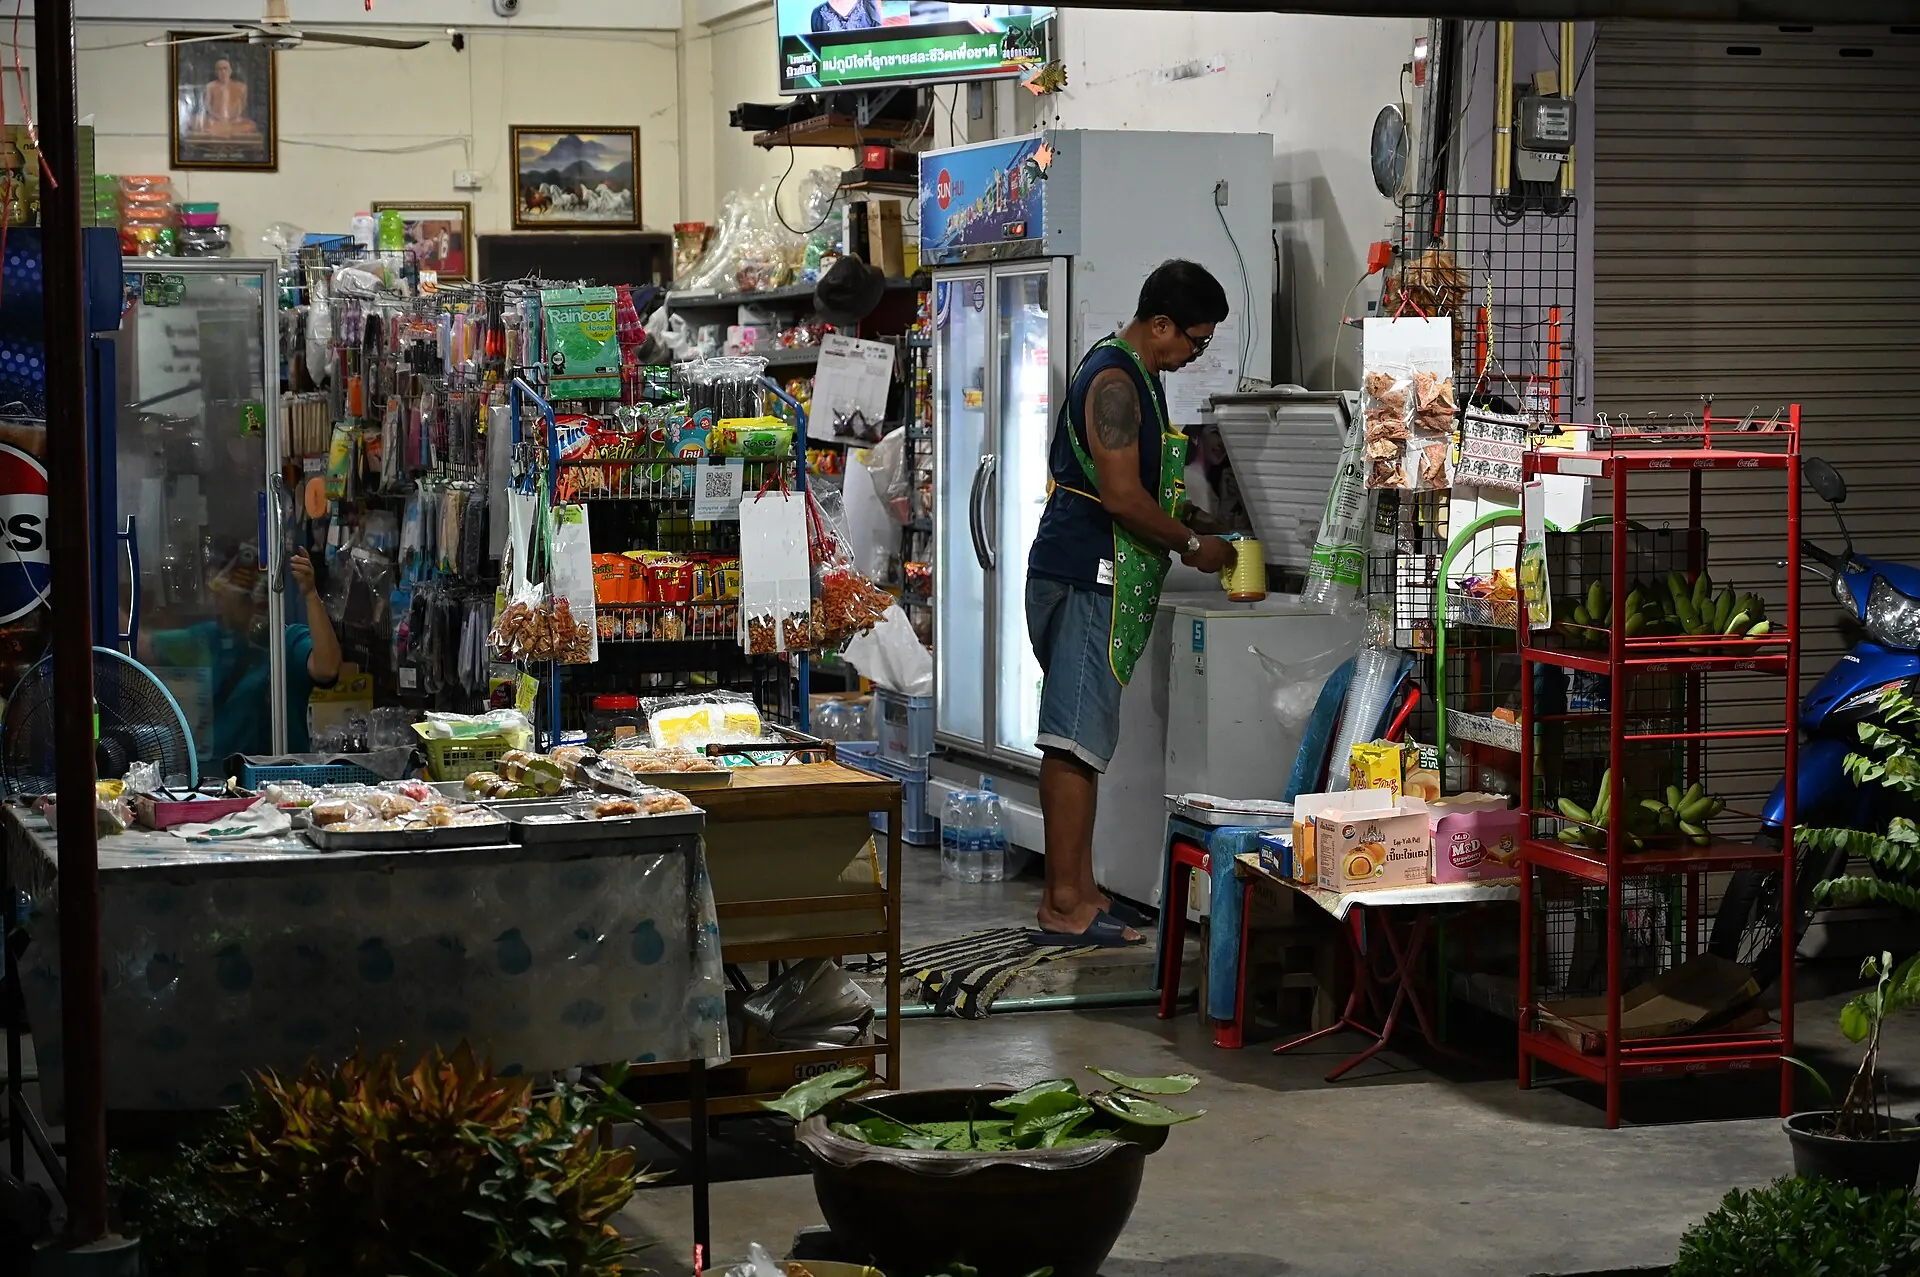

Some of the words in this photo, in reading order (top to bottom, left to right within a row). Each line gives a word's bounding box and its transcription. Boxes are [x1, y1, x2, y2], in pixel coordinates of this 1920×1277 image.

[822, 42, 998, 74] แม่ภูมิใจที่ลูกชายสละชีวิตเพื่อชาติ
[937, 181, 951, 199] SUN
[951, 180, 965, 197] HUI
[547, 305, 613, 323] Raincoat
[1649, 459, 1671, 468] Coca-Cola
[1693, 459, 1716, 467] Coca-Cola
[1737, 459, 1759, 468] Coca-Cola
[1386, 847, 1429, 862] เปี๊ยะไข่แดง
[1451, 839, 1481, 857] M&D
[1452, 851, 1481, 863] Strawberry
